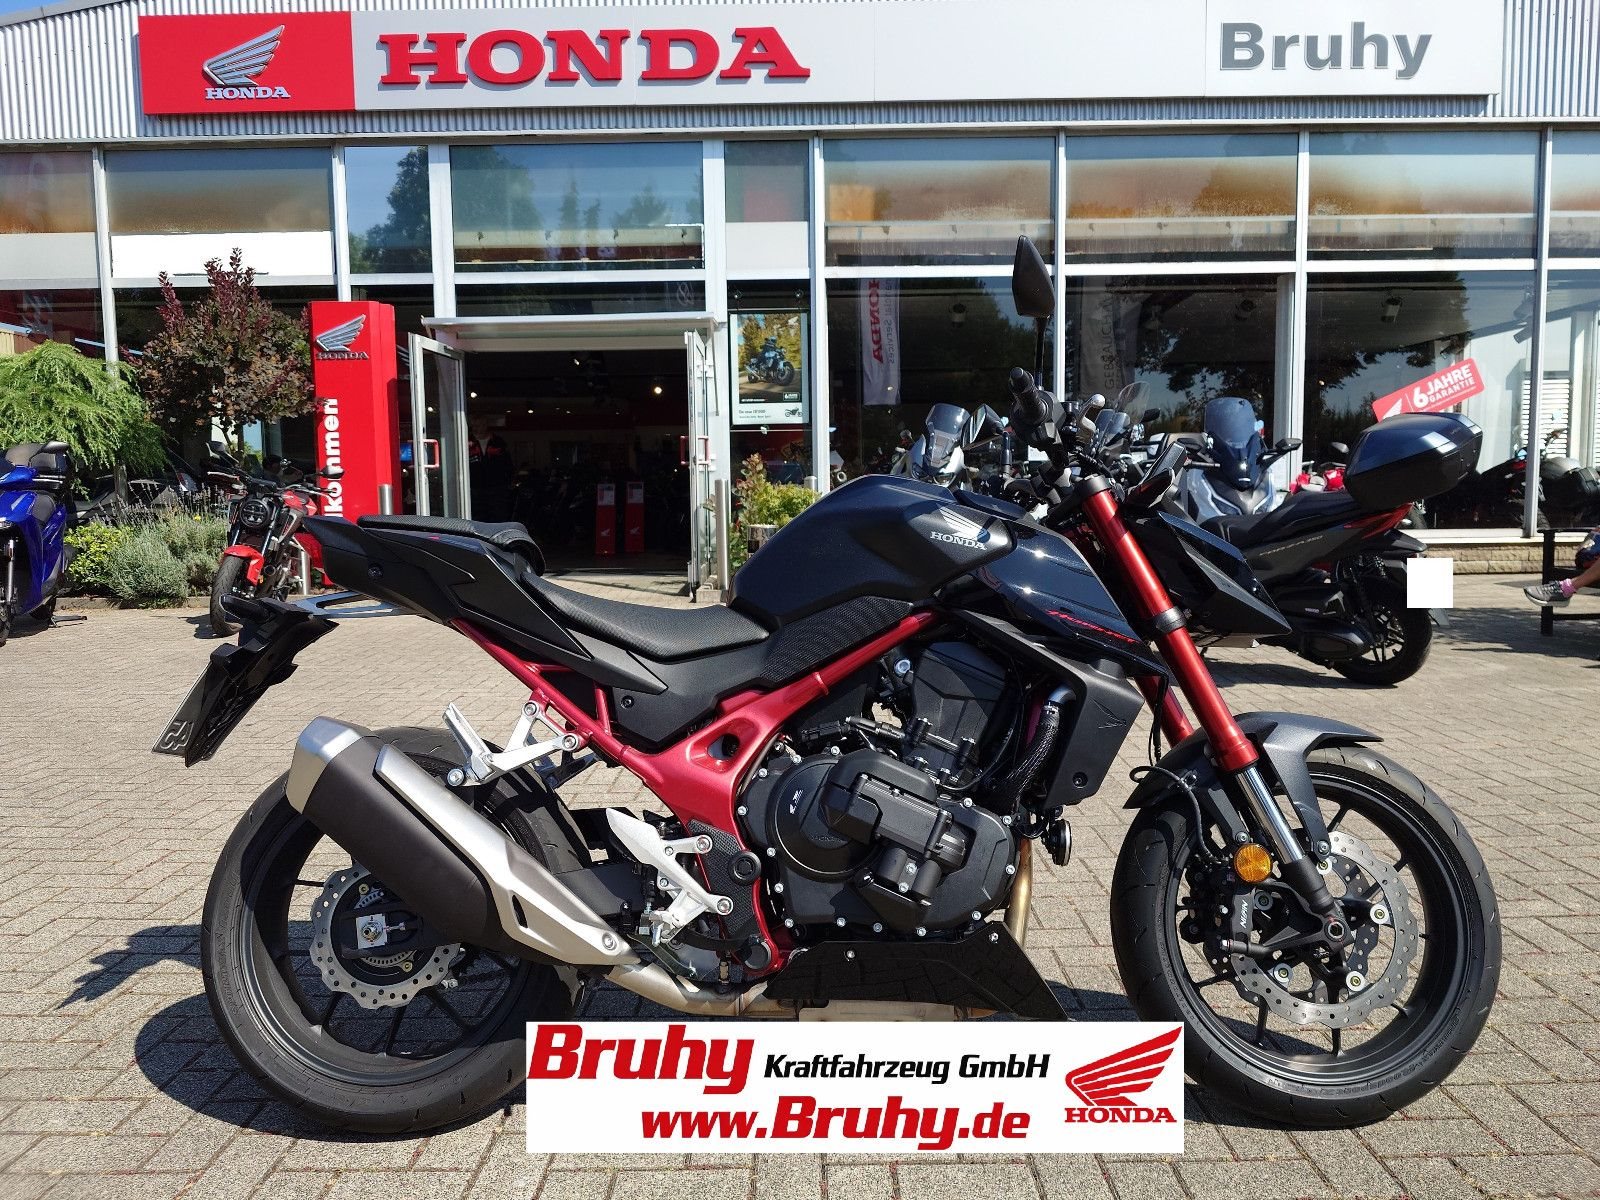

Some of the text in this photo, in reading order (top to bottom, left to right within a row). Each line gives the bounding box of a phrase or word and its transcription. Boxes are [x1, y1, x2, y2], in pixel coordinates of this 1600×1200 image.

[379, 27, 810, 85] HONDA
[1220, 22, 1432, 80] Bruhy
[205, 86, 291, 99] HONDA
[317, 351, 369, 361] HONDA
[1413, 364, 1473, 409] 6 JAHRE
[1428, 377, 1475, 403] GARANTIE
[930, 531, 988, 551] HONDA
